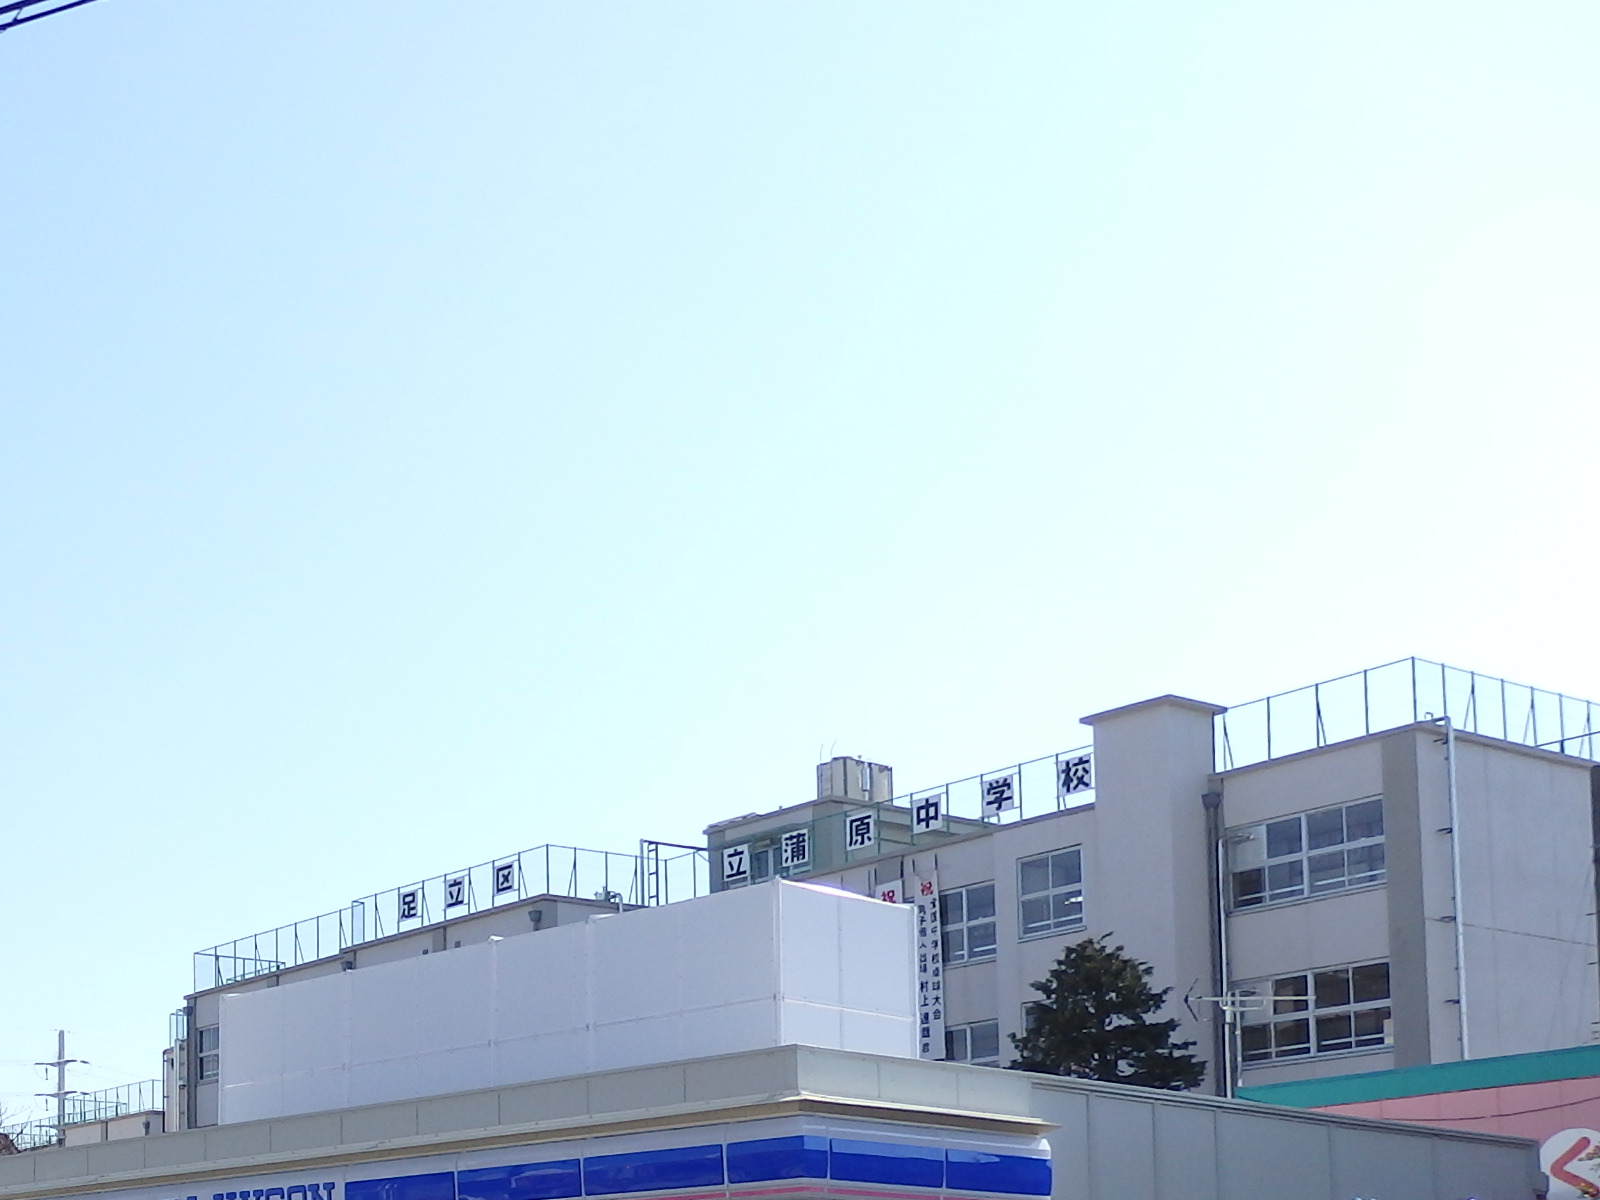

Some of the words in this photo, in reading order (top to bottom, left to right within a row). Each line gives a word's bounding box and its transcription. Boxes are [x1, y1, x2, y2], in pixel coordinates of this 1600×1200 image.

[401, 863, 512, 919] 足立区
[725, 757, 1091, 879] 立蒲原中学校
